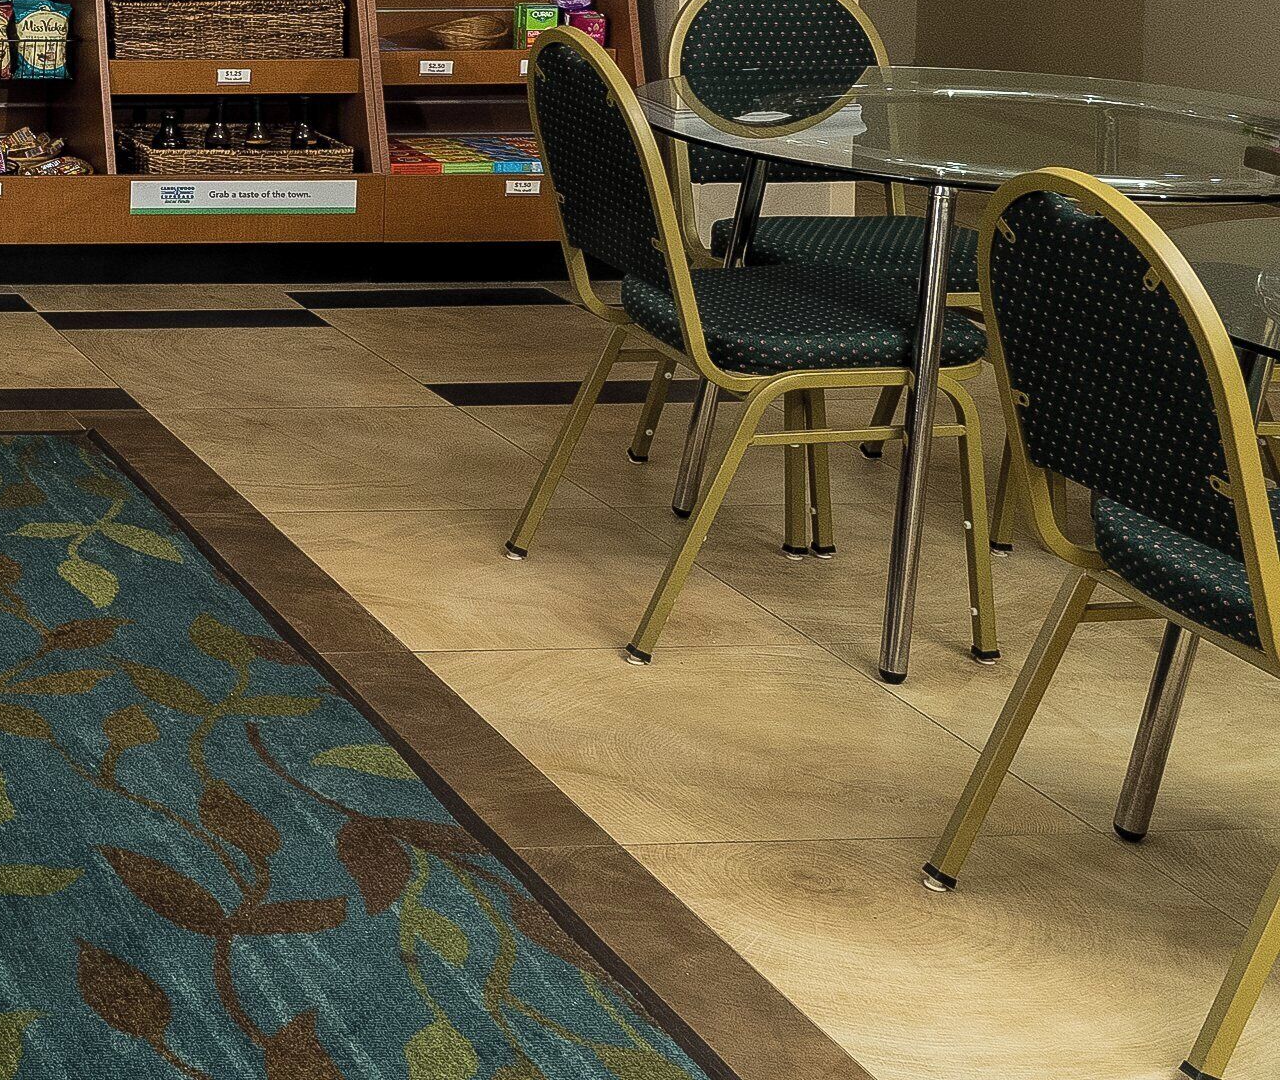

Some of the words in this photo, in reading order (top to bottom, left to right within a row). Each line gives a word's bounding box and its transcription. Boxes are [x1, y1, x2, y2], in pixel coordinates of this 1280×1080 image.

[531, 10, 554, 19] CURAD
[22, 20, 43, 33] Miss
[209, 190, 230, 198] Grab
[261, 190, 271, 198] of
[272, 190, 286, 198] the
